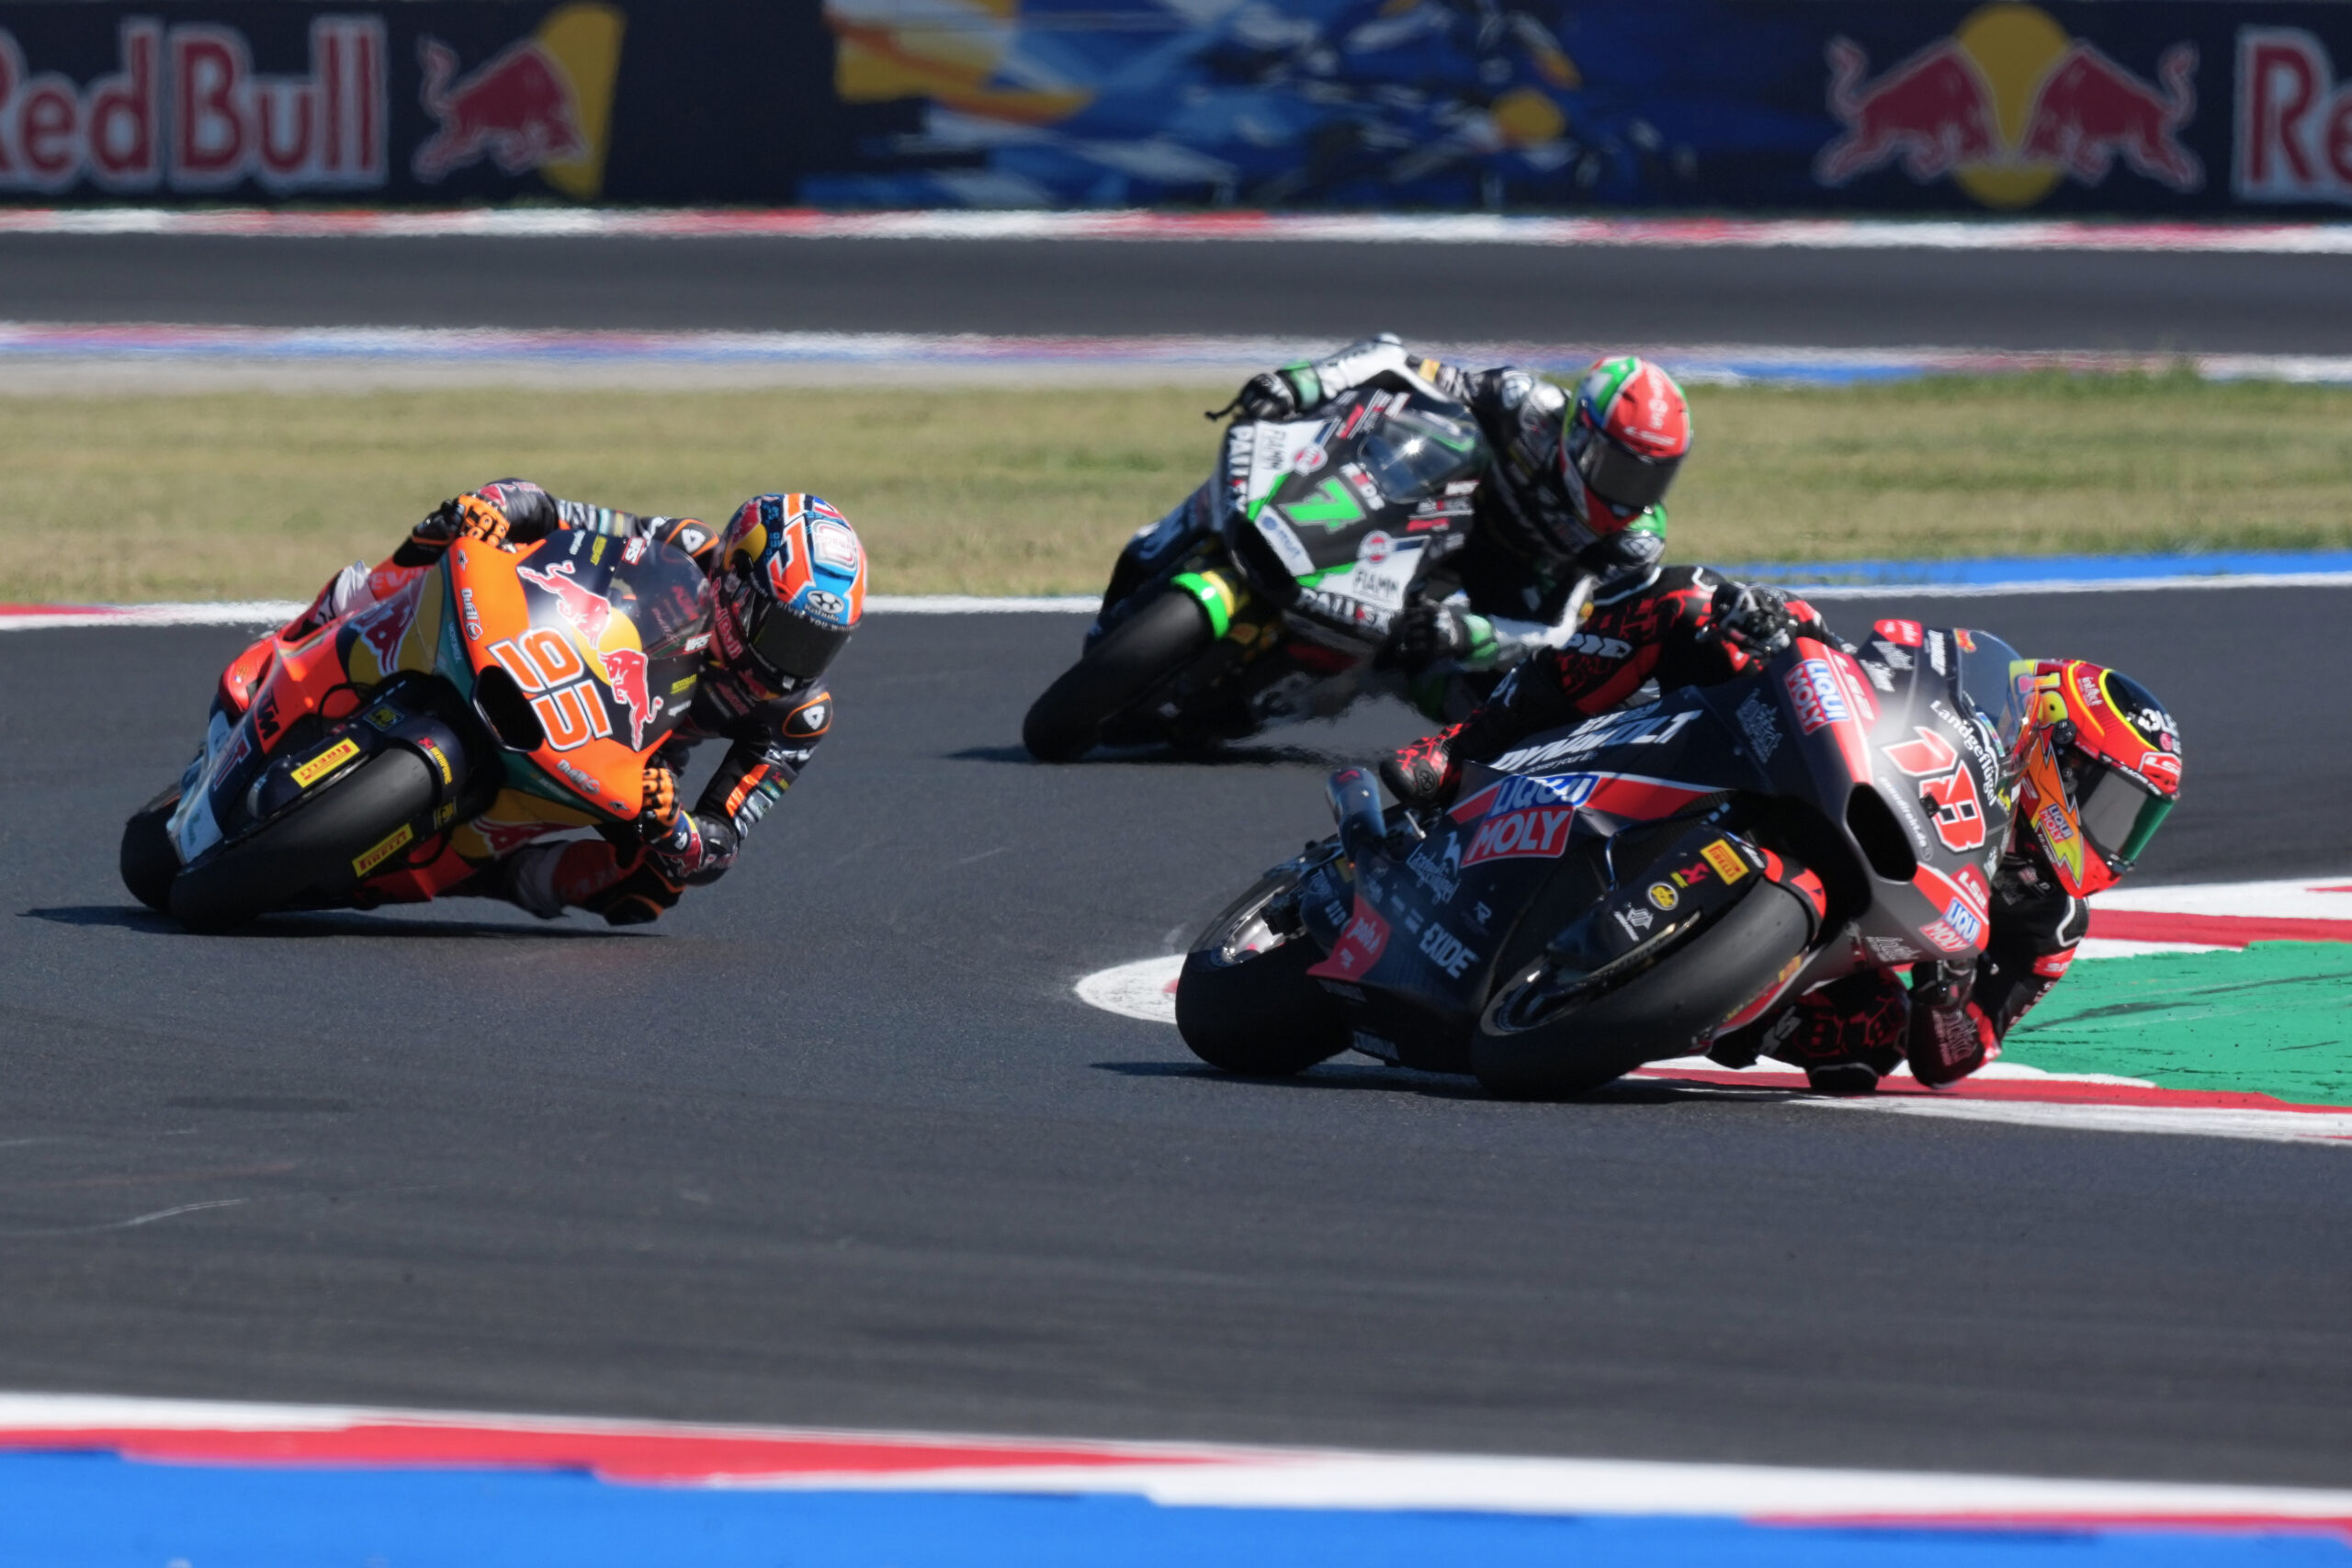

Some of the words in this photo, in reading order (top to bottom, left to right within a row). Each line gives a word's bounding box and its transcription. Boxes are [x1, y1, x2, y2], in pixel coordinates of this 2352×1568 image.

[166, 15, 388, 190] Bull
[1278, 475, 1367, 534] 7
[485, 626, 614, 753] 95
[1789, 666, 1825, 730] MOLY
[1805, 661, 1850, 720] LIQUI
[1487, 709, 1704, 772] DYNAVOLT
[1929, 699, 1999, 807] Landgeflügel
[1489, 776, 1594, 817] LIQUI
[2041, 808, 2064, 843] MOLY
[2049, 802, 2074, 839] LIQUI
[1472, 810, 1571, 857] MOLY
[1927, 920, 1970, 951] MOLY
[1946, 899, 1981, 940] LIQUI
[1419, 921, 1480, 981] EXIDE
